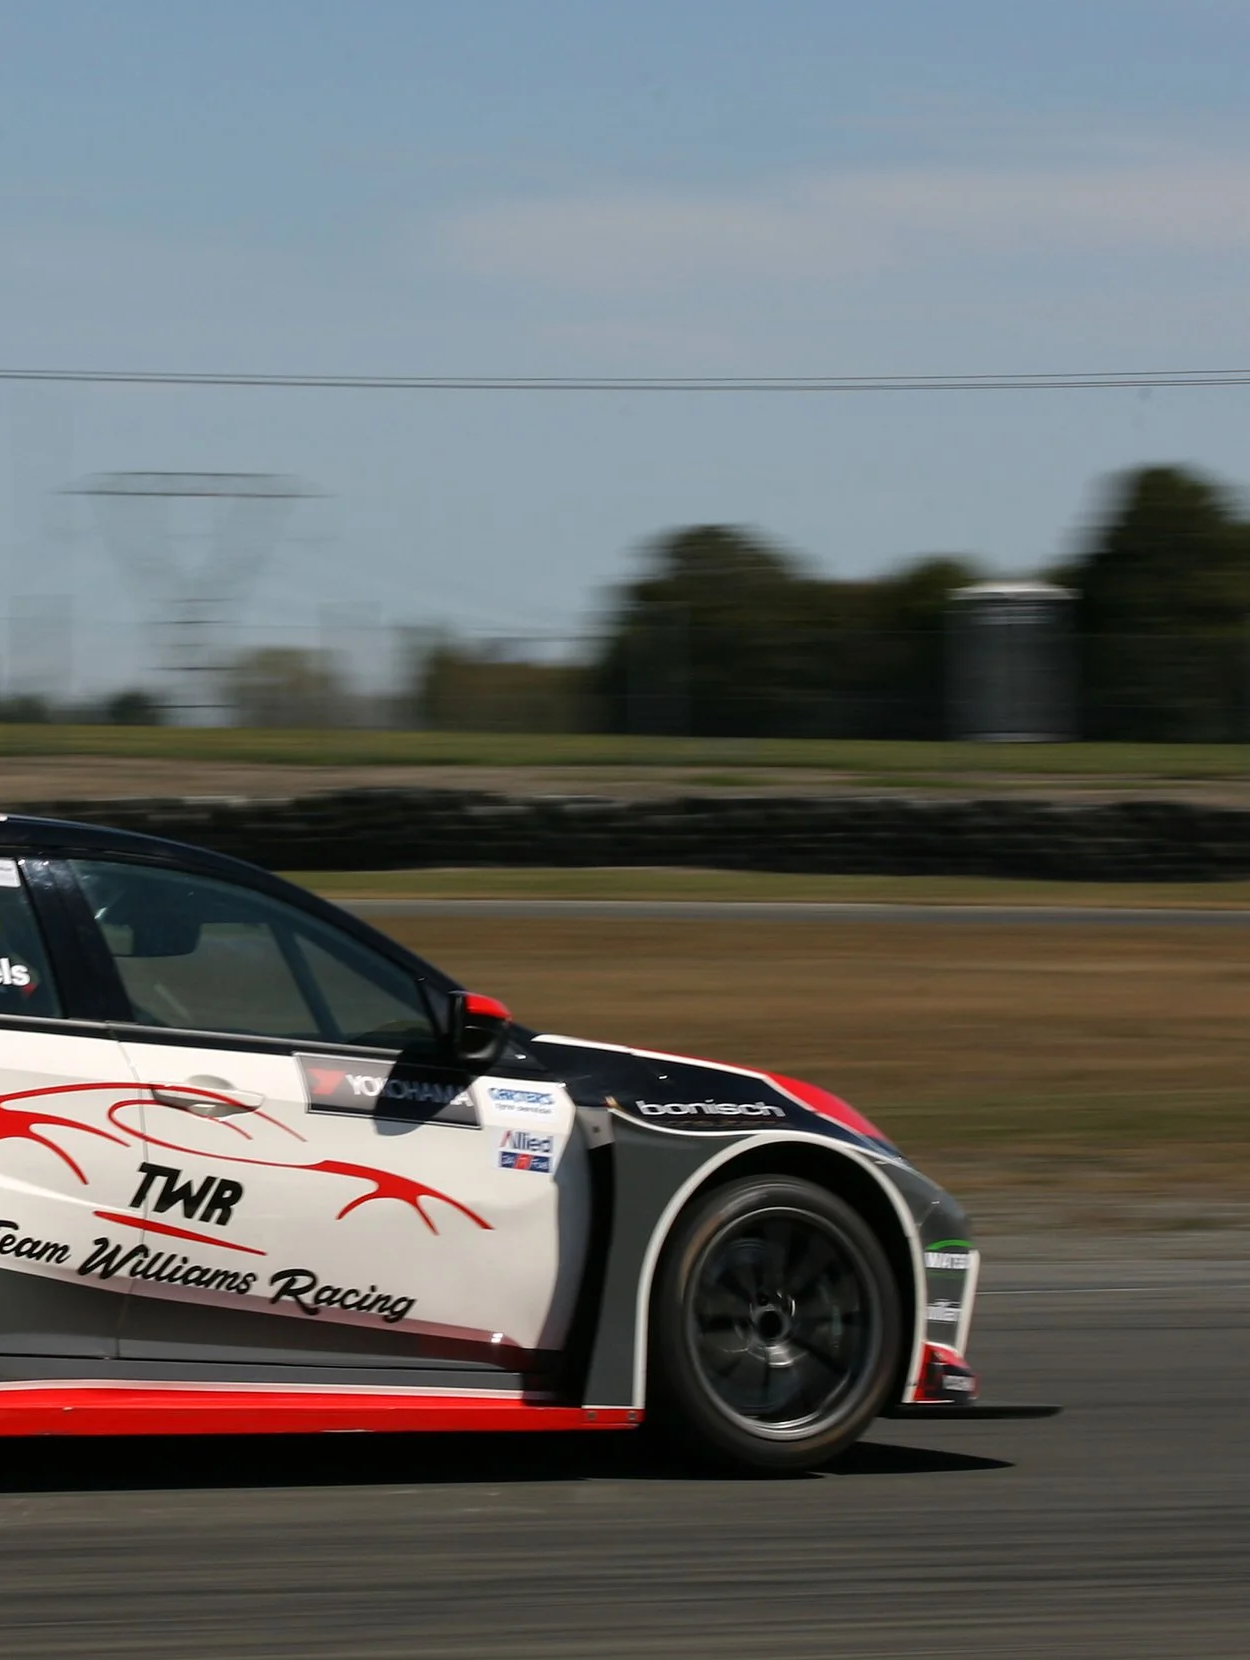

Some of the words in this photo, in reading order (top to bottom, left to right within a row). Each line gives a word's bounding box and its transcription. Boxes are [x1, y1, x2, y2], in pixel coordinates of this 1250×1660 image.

[345, 1073, 475, 1107] YOKOHAMA
[635, 1099, 786, 1117] bonisch
[500, 1130, 554, 1153] Allied
[129, 1161, 244, 1226] TWR
[77, 1237, 257, 1295] Williams
[269, 1269, 417, 1324] Racing
